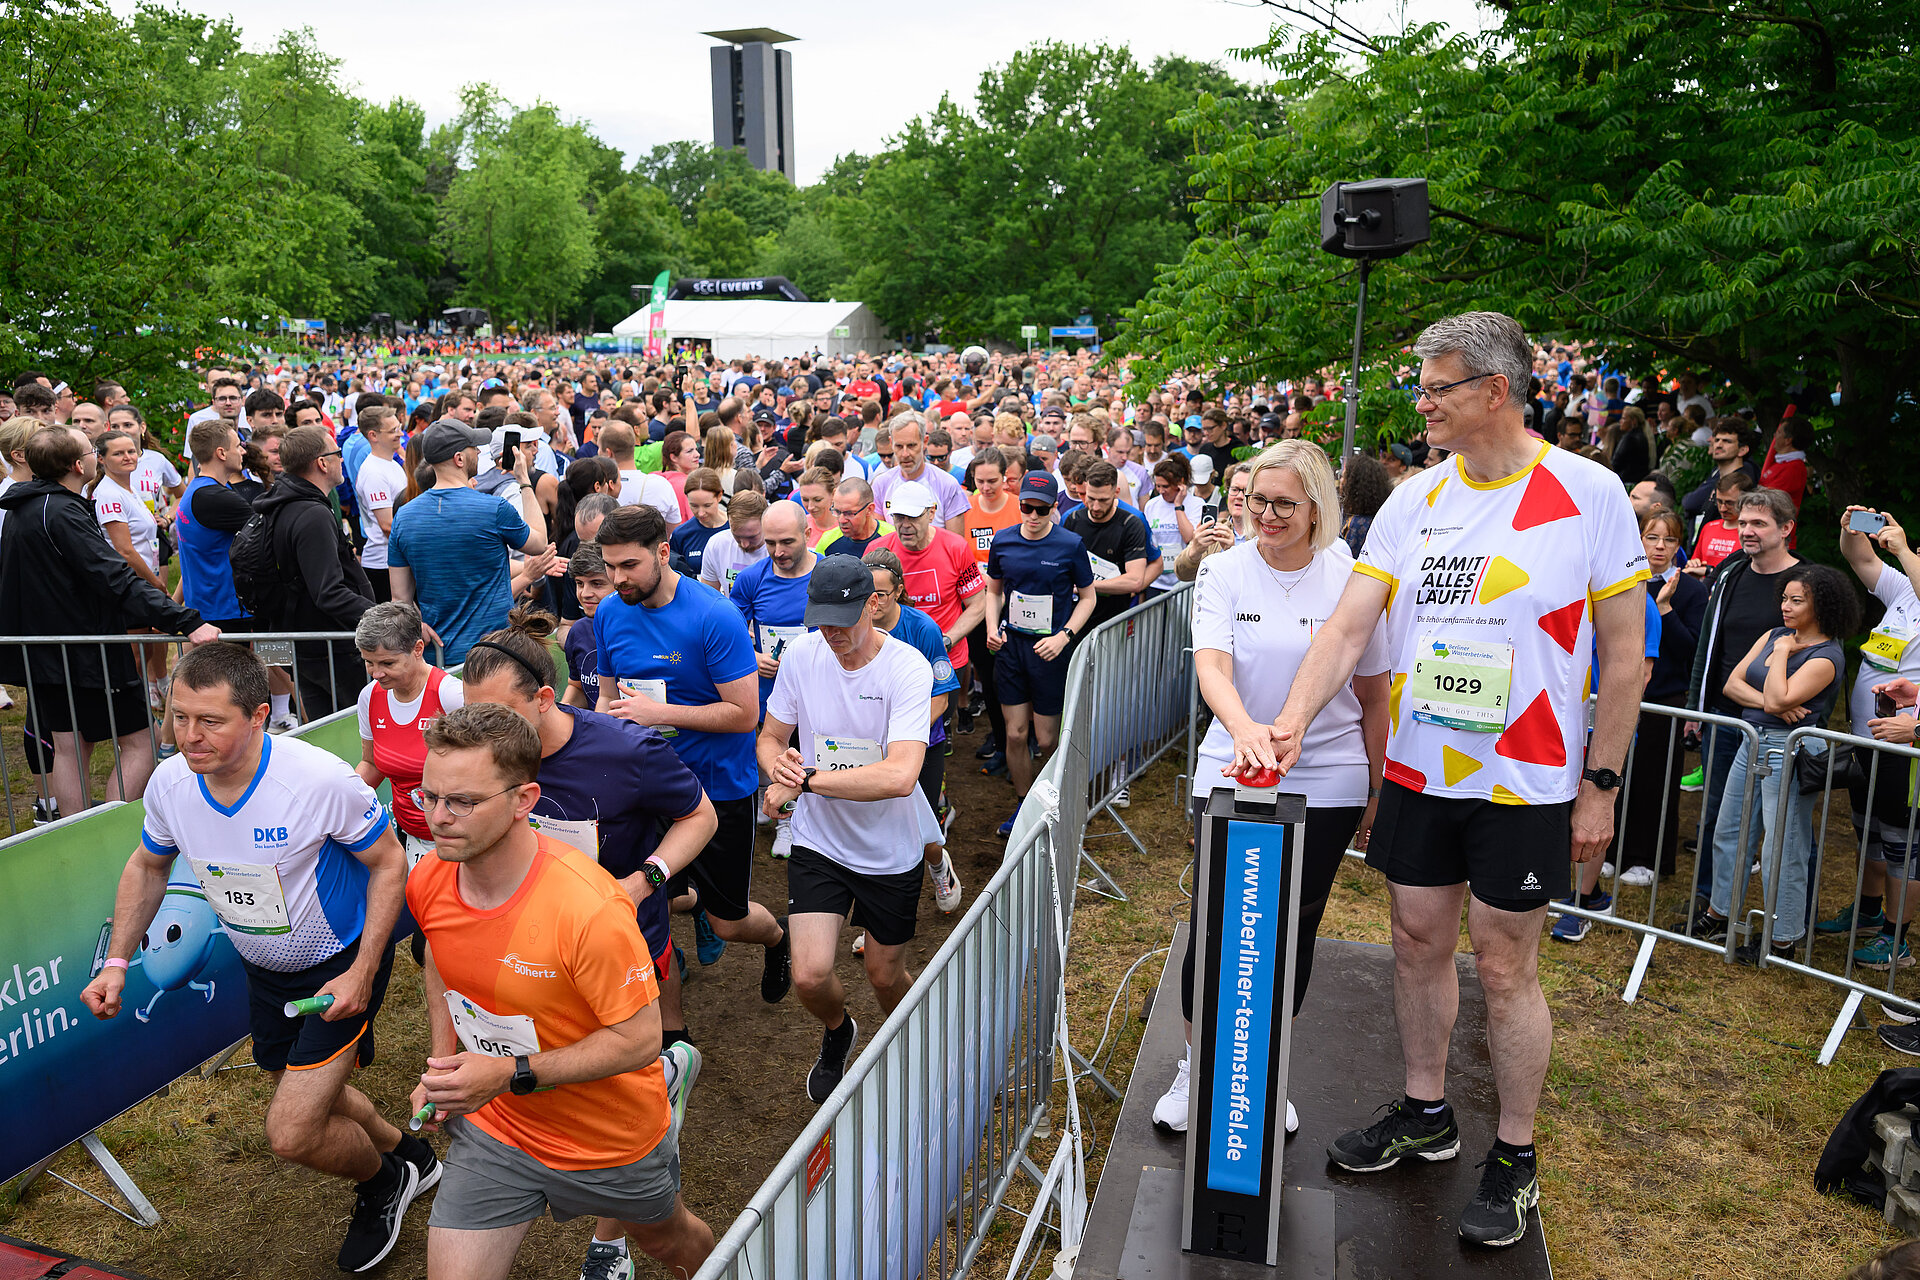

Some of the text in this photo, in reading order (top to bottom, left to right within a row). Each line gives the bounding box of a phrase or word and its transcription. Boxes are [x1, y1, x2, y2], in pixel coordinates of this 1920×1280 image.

[693, 280, 764, 294] SCC EVENTS
[140, 480, 159, 493] ILB
[370, 491, 387, 502] ILB
[101, 503, 122, 515] ILB
[971, 527, 993, 537] Team
[1711, 538, 1736, 547] ZUHAUSE
[1420, 555, 1486, 571] DAMIT
[1421, 572, 1476, 588] ALLES
[1415, 589, 1472, 605] LÄUFT
[1022, 610, 1036, 619] 121
[1236, 613, 1261, 622] JAKO
[1488, 617, 1508, 625] BMV
[1448, 643, 1470, 651] Berliner
[1451, 650, 1494, 660] Wasserbetriebe
[1416, 662, 1422, 673] C
[1434, 674, 1482, 695] 1029
[1495, 695, 1502, 706] 2
[830, 763, 864, 771] 201
[253, 826, 289, 842] DKB
[542, 825, 580, 834] Wasserbetriebe
[225, 890, 255, 906] 183
[275, 904, 280, 913] 1
[514, 965, 557, 978] 50hertz
[1226, 847, 1262, 1162] www.berliner-teamstaffel.de
[473, 1034, 514, 1057] 1015
